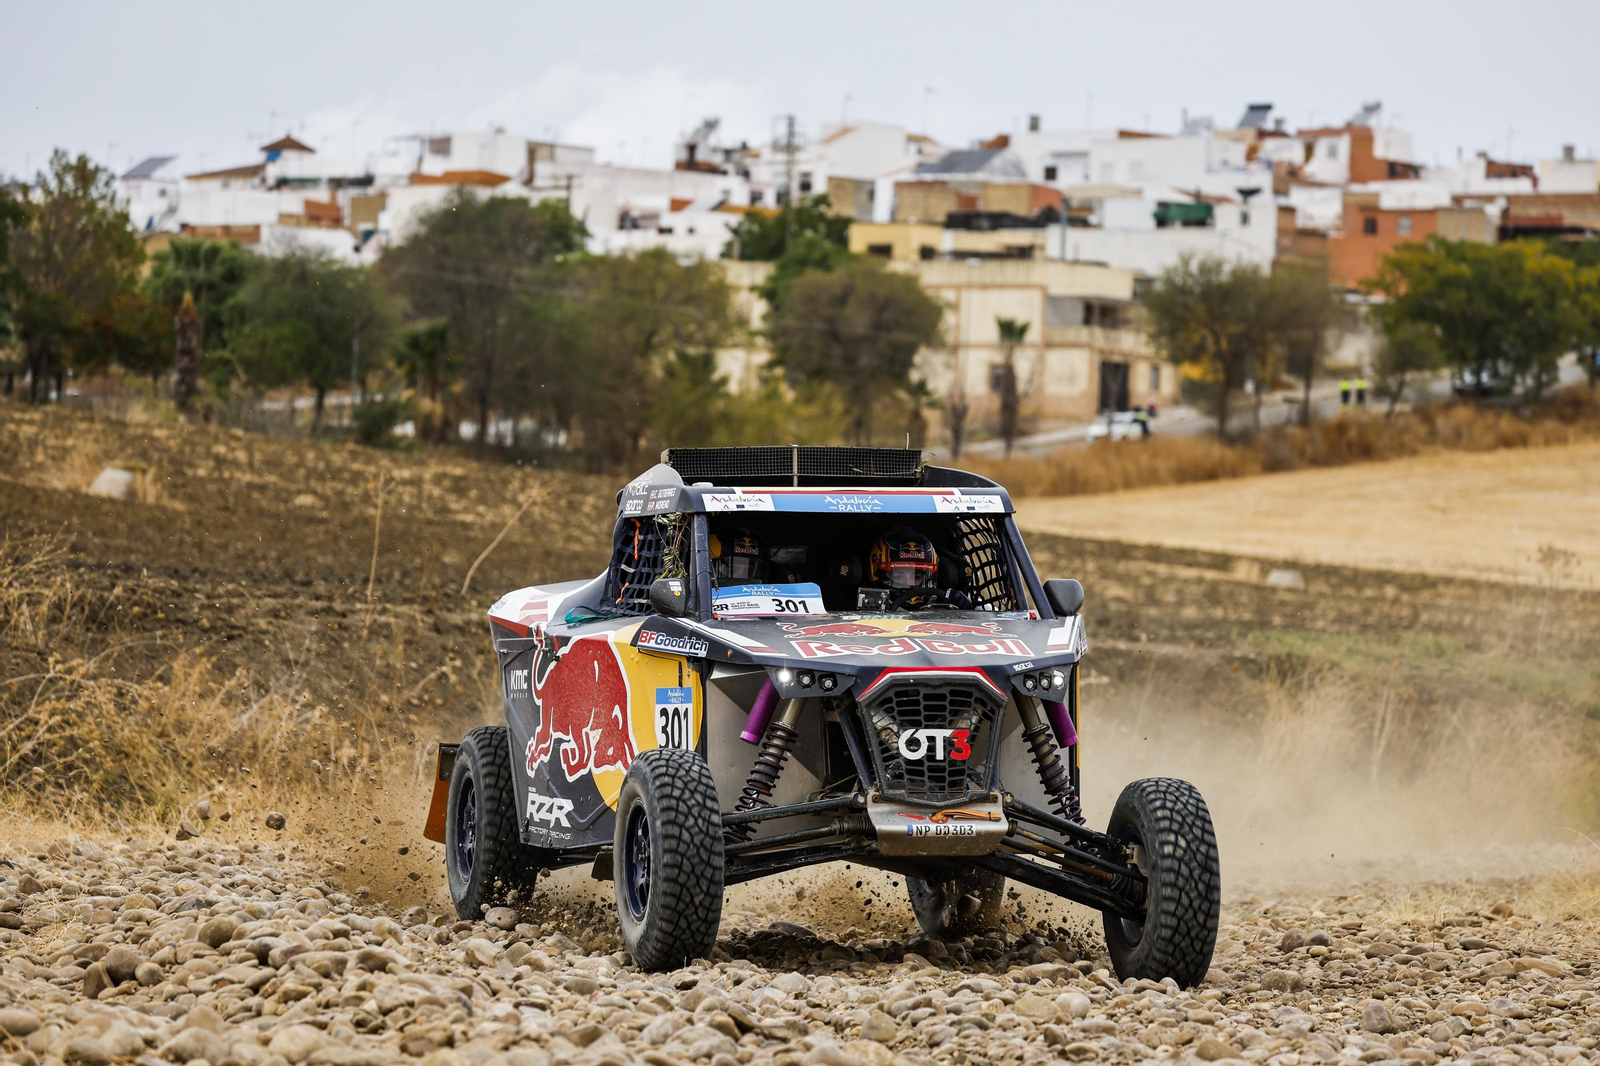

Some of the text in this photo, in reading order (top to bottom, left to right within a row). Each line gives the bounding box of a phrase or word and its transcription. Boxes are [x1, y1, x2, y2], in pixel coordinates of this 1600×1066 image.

[824, 494, 884, 505] Andalucía
[839, 504, 873, 512] RALLY
[899, 551, 925, 559] Red Bull
[771, 598, 810, 614] 301
[638, 630, 708, 653] BFGoodrich
[789, 637, 1036, 659] Red Bull
[510, 669, 529, 690] KMC
[659, 707, 689, 750] 301
[526, 792, 575, 829] RZR
[915, 825, 931, 836] NP
